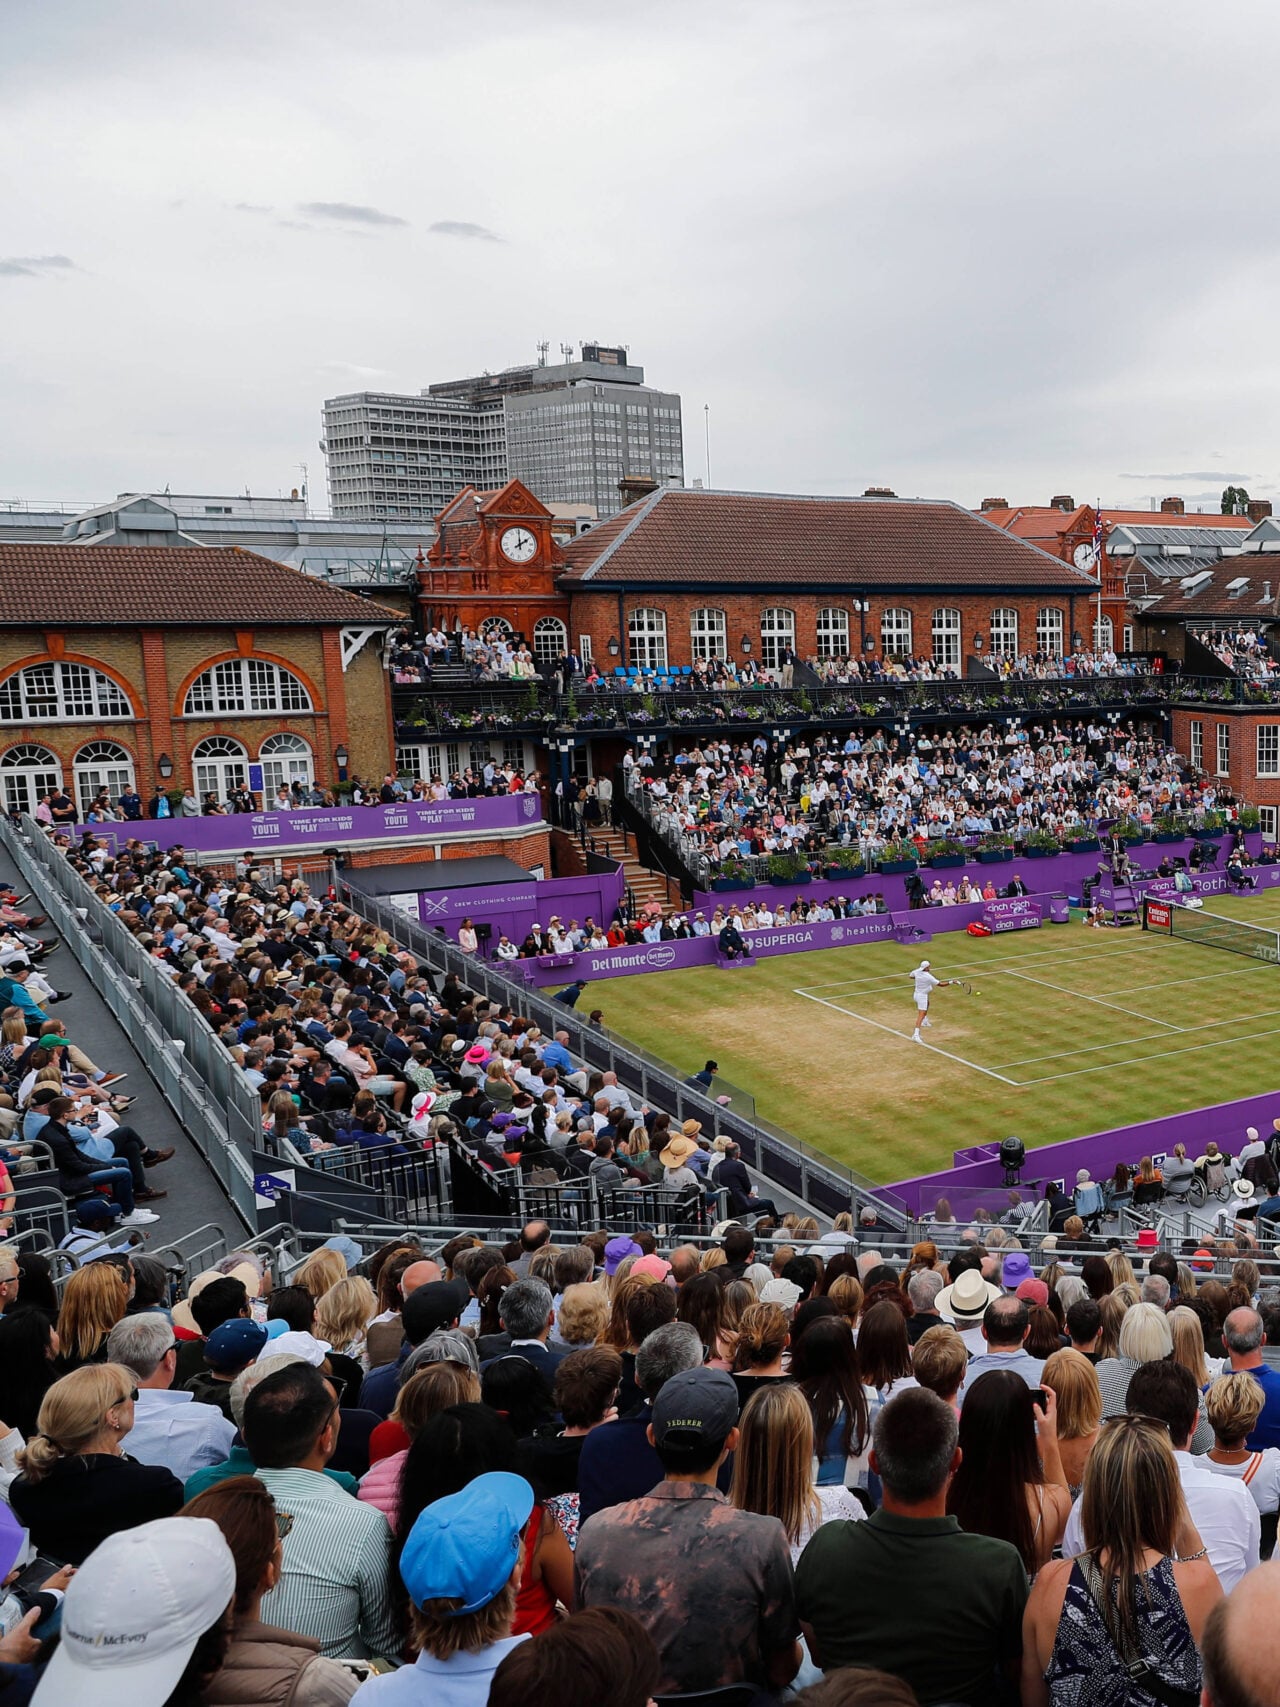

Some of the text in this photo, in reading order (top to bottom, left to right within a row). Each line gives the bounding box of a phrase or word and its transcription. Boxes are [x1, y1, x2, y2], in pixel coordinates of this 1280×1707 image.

[384, 815, 408, 826] YOUTH
[427, 815, 443, 823] PLAY
[462, 813, 475, 821] WAY
[252, 824, 280, 835] YOUTH
[300, 824, 317, 832] PLAY
[339, 821, 352, 830] WAY
[988, 901, 1008, 912] cinch
[996, 921, 1014, 929] cinch
[1021, 917, 1038, 926] cinch
[847, 925, 898, 936] healthsp
[755, 932, 812, 948] SUPERGA
[592, 954, 646, 971] Del Monte
[667, 1419, 702, 1427] FEDERER
[104, 1632, 149, 1646] McEvoy
